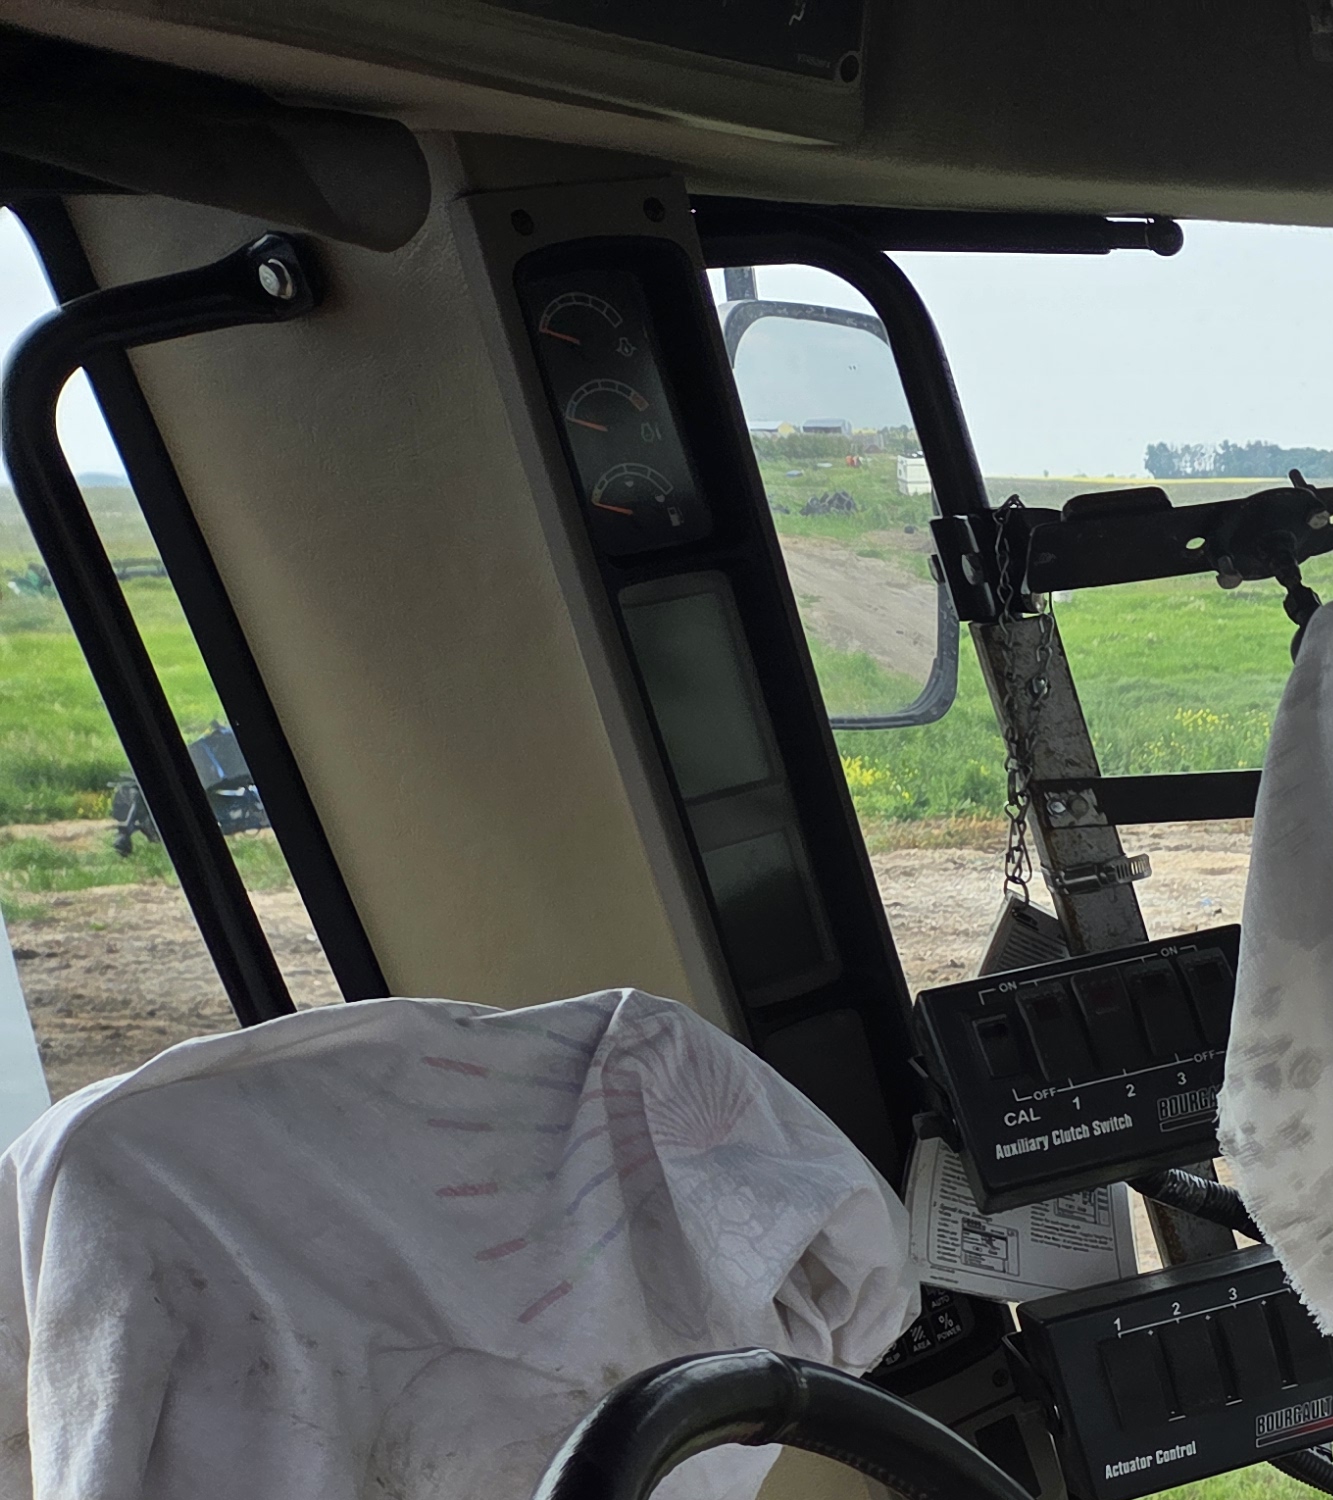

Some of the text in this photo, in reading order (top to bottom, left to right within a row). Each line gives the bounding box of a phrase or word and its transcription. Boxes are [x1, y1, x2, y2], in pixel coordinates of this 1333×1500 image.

[1160, 945, 1179, 957] ON
[998, 981, 1018, 993] ON
[1193, 1050, 1216, 1064] OFF
[1177, 1072, 1187, 1086] 3
[1033, 1087, 1057, 1102] OFF
[1125, 1083, 1137, 1098] 2
[1072, 1097, 1082, 1111] 1
[1157, 1084, 1221, 1121] BOURGA
[1004, 1107, 1042, 1127] CAL
[995, 1113, 1133, 1160] Auxiliary Clutch Switch
[931, 1294, 950, 1309] AUTO
[1228, 1287, 1239, 1302] 3
[1171, 1302, 1182, 1316] 2
[1113, 1317, 1122, 1332] 1
[936, 1324, 962, 1342] POWER
[913, 1338, 932, 1353] AREA
[1104, 1440, 1198, 1480] Actuator Control
